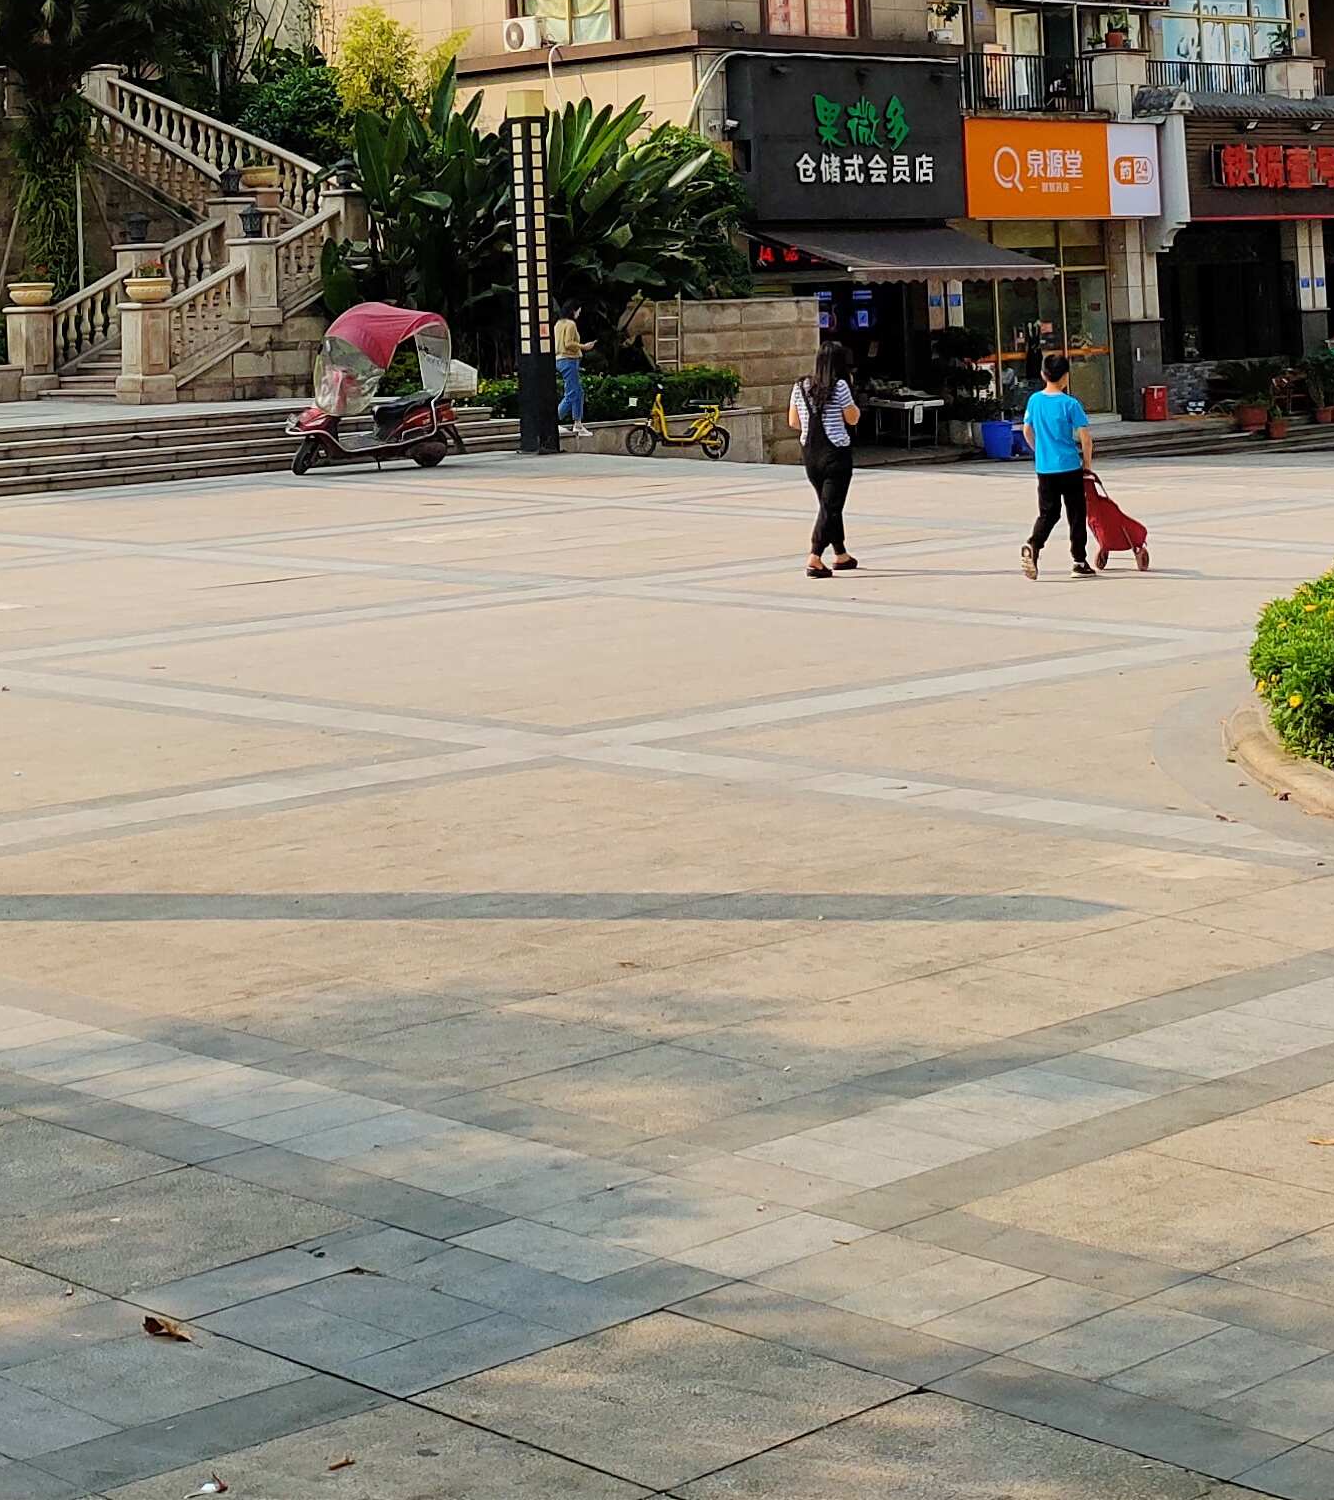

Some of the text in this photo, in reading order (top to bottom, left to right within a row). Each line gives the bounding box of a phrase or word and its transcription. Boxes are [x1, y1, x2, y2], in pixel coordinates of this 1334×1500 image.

[796, 152, 936, 184] 仓储式会员店
[1027, 148, 1084, 179] 泉源堂
[1135, 160, 1148, 174] 24
